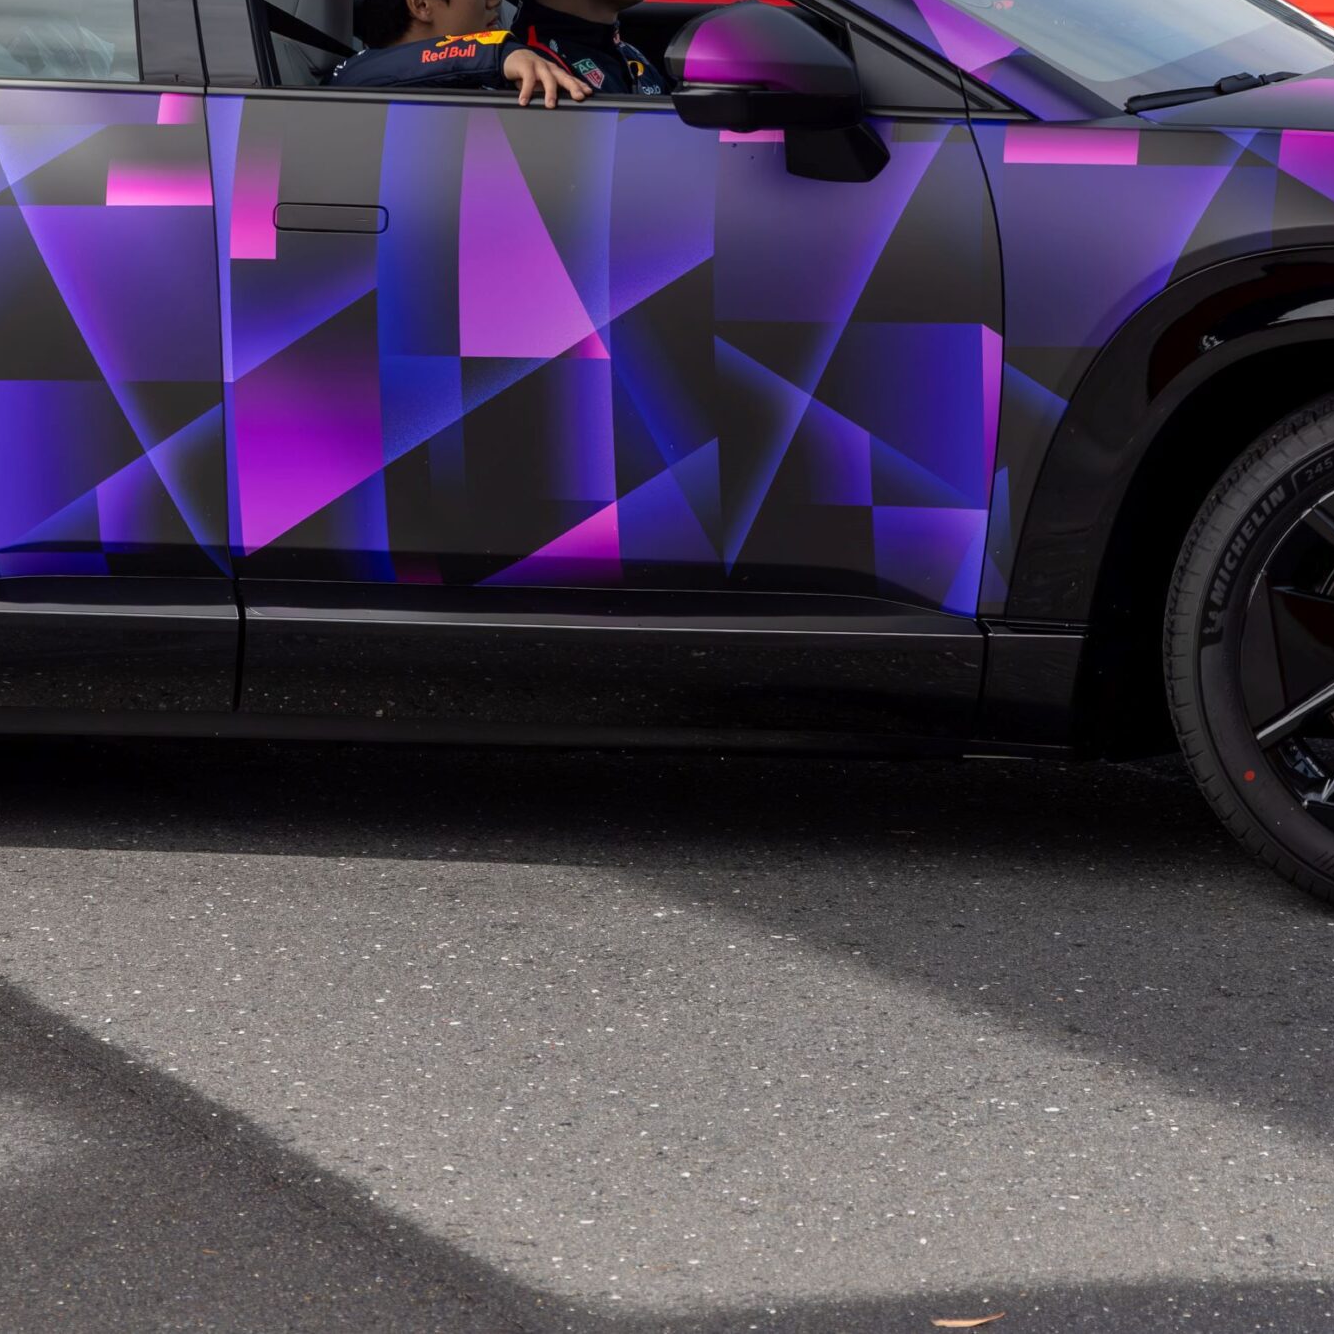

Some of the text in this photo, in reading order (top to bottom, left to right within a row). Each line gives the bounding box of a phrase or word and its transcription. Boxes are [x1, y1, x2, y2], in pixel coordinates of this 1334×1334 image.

[421, 44, 476, 63] Red Bull
[1210, 484, 1287, 606] MICHELIN
